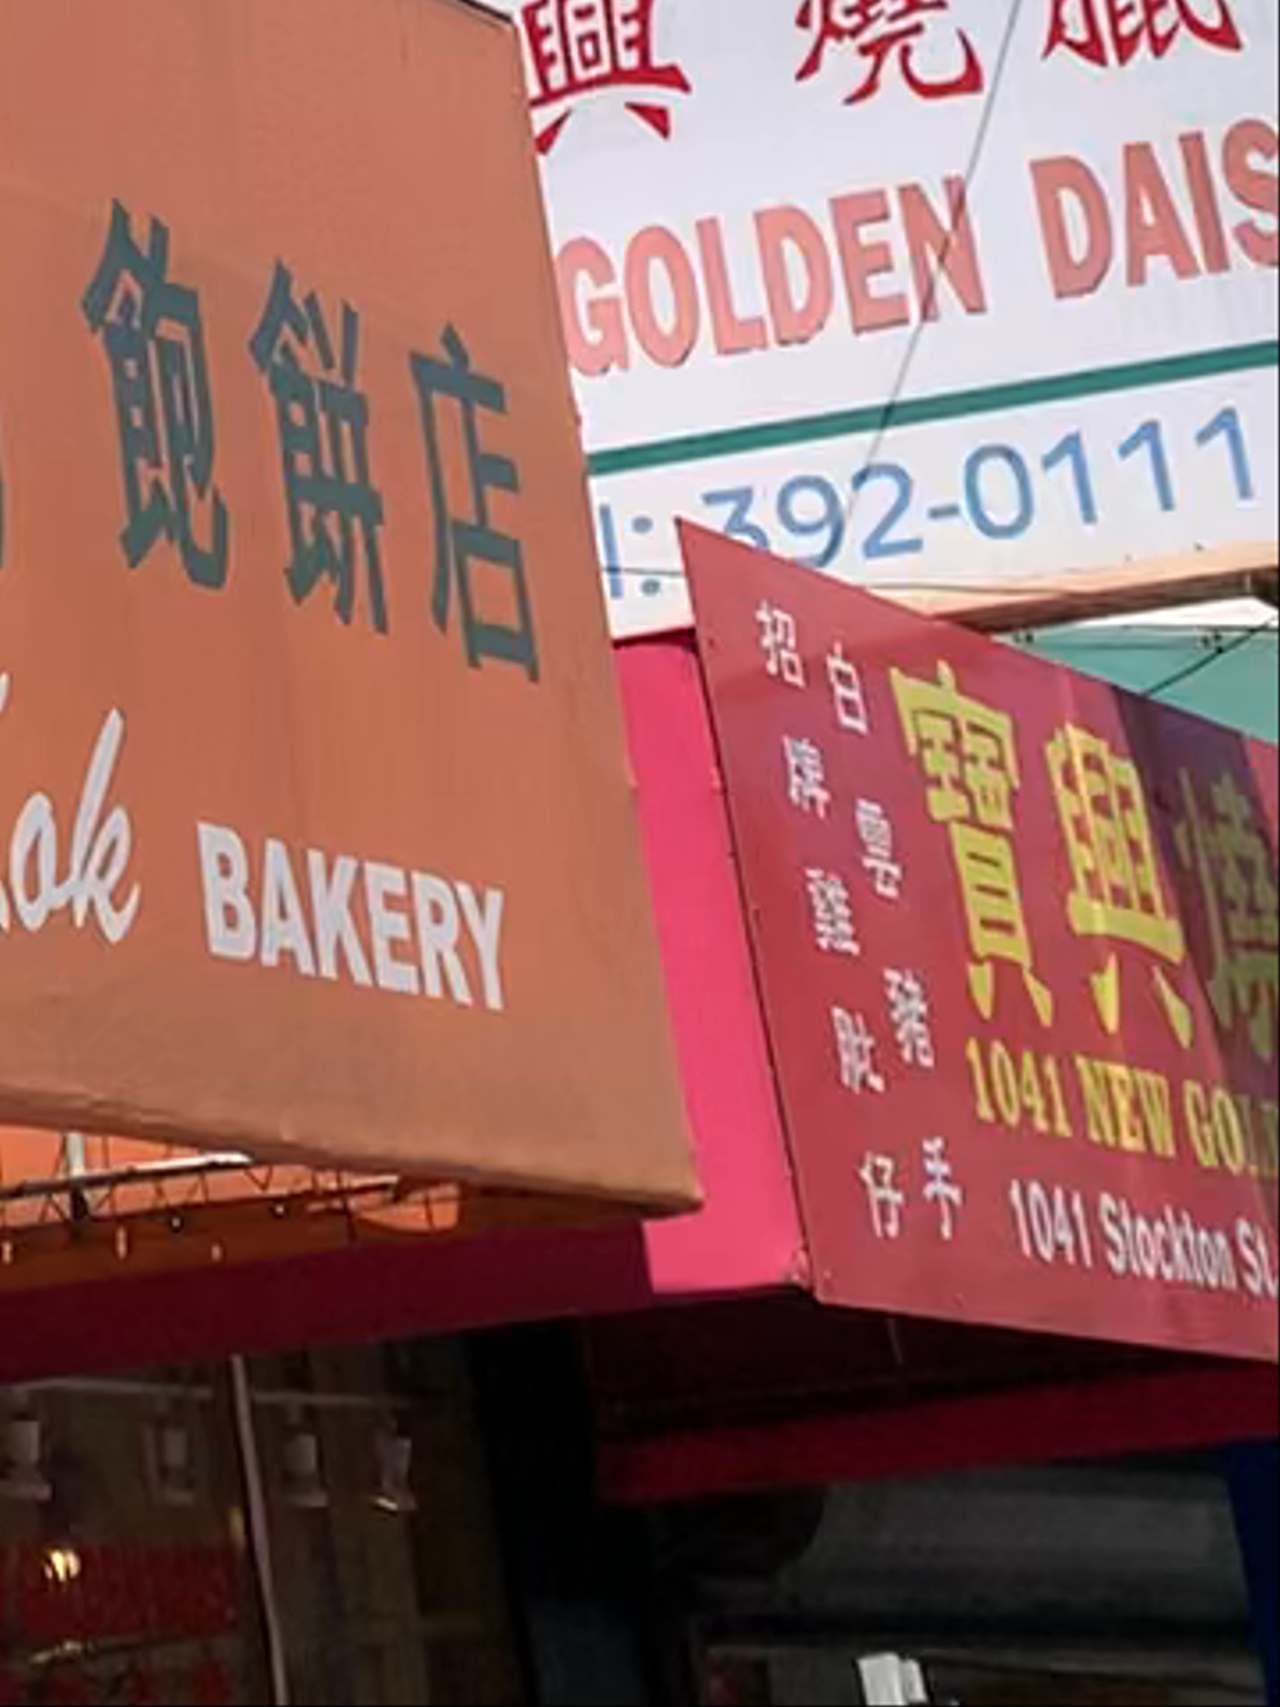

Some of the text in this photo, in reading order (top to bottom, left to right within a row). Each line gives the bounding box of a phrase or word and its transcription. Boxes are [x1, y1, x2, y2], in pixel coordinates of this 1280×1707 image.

[556, 172, 988, 378] GOLDEN
[81, 197, 539, 683] 飽餅店
[702, 405, 1256, 570] 392-0111
[197, 820, 507, 1011] BAKERY
[966, 1036, 1073, 1139] 1041
[1075, 1053, 1176, 1157] NEW
[1009, 1178, 1093, 1269] 1041
[1099, 1191, 1238, 1292] Stockton
